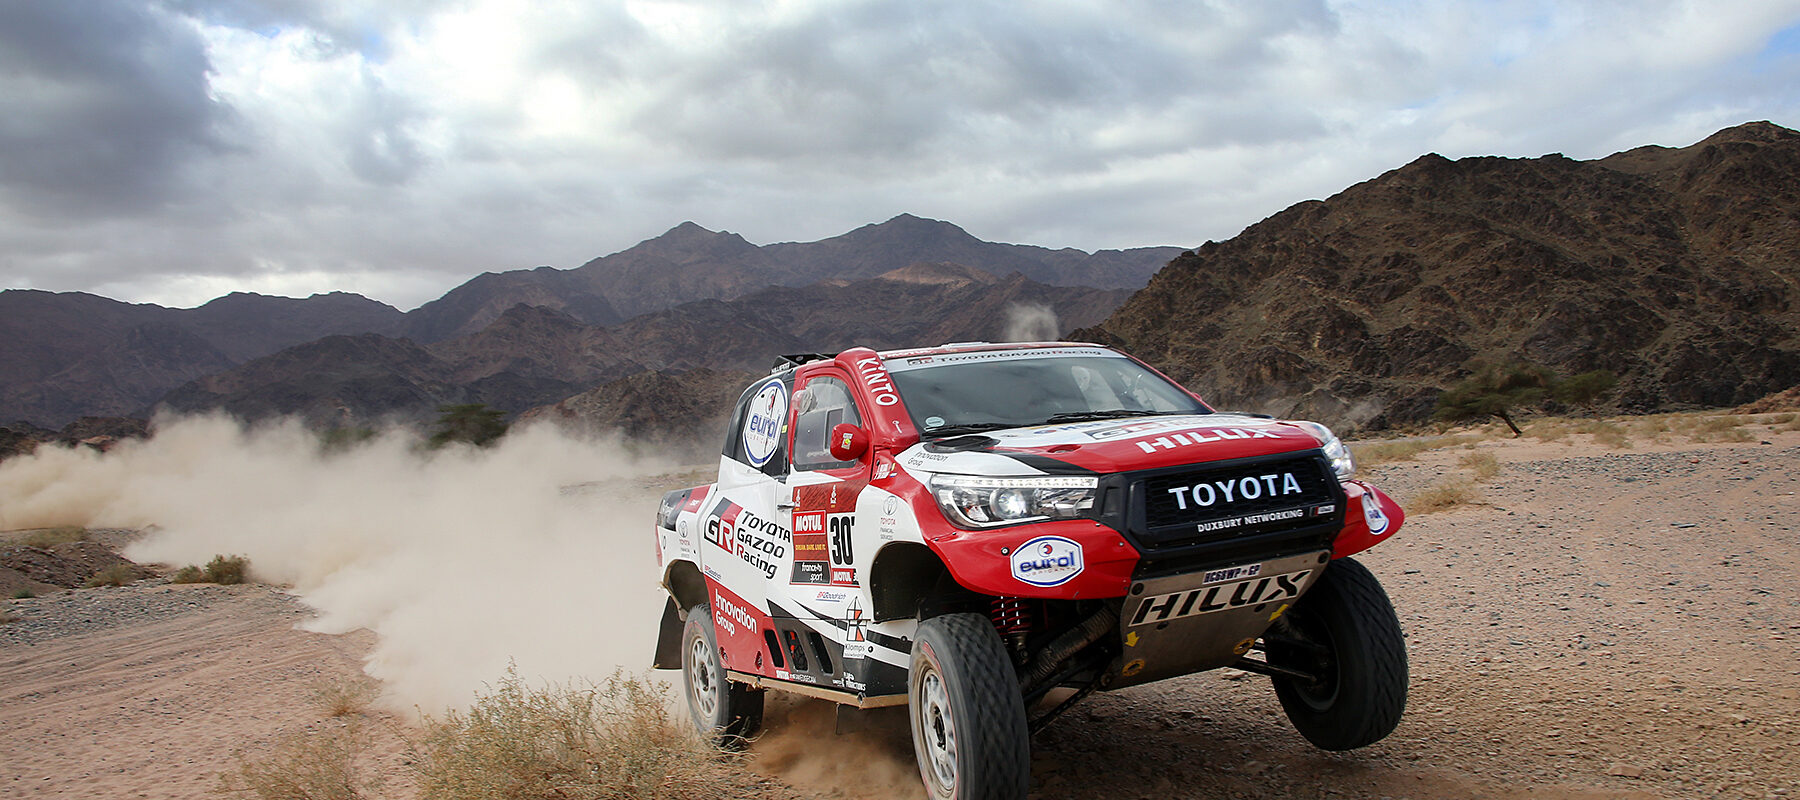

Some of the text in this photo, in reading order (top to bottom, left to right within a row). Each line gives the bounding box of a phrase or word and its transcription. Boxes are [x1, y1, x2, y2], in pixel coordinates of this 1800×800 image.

[940, 354, 997, 362] TOYOTA
[750, 414, 780, 438] eurol
[1136, 427, 1281, 454] HILUX
[1168, 473, 1302, 510] TOYOTA
[704, 513, 734, 553] GR
[742, 511, 791, 543] TOYOTA
[795, 514, 823, 532] MOTUL
[1197, 518, 1242, 532] DUXBURY
[1244, 510, 1304, 525] NETWORKING
[737, 527, 785, 559] GAZOO
[830, 516, 855, 566] 30
[736, 543, 778, 579] Racing
[1020, 551, 1076, 573] eurol
[833, 571, 852, 582] MOTUL
[715, 588, 758, 634] Innovation
[1131, 570, 1311, 625] HILUX
[715, 610, 735, 637] Group
